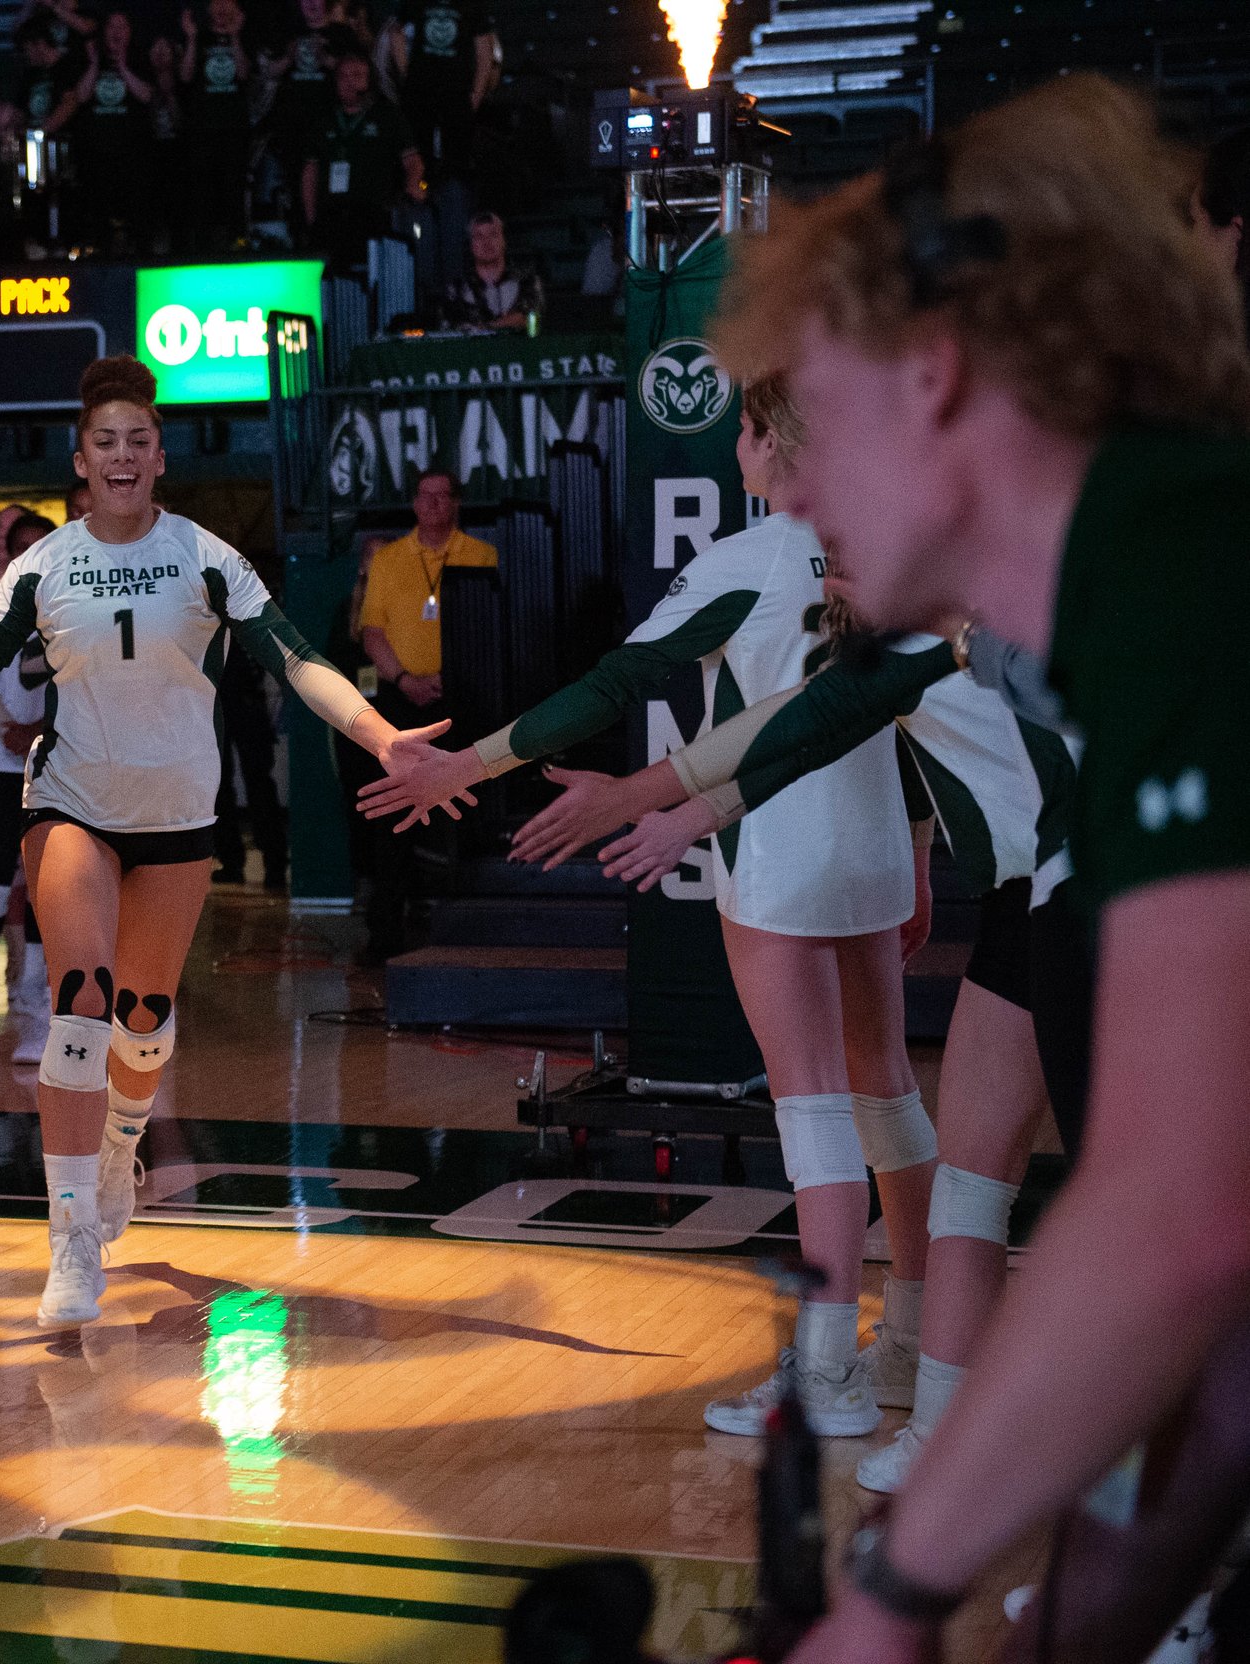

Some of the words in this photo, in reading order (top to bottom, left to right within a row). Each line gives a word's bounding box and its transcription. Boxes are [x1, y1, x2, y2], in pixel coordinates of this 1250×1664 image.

[69, 564, 180, 586] COLORADO
[92, 581, 157, 598] STATE
[113, 607, 135, 661] 1
